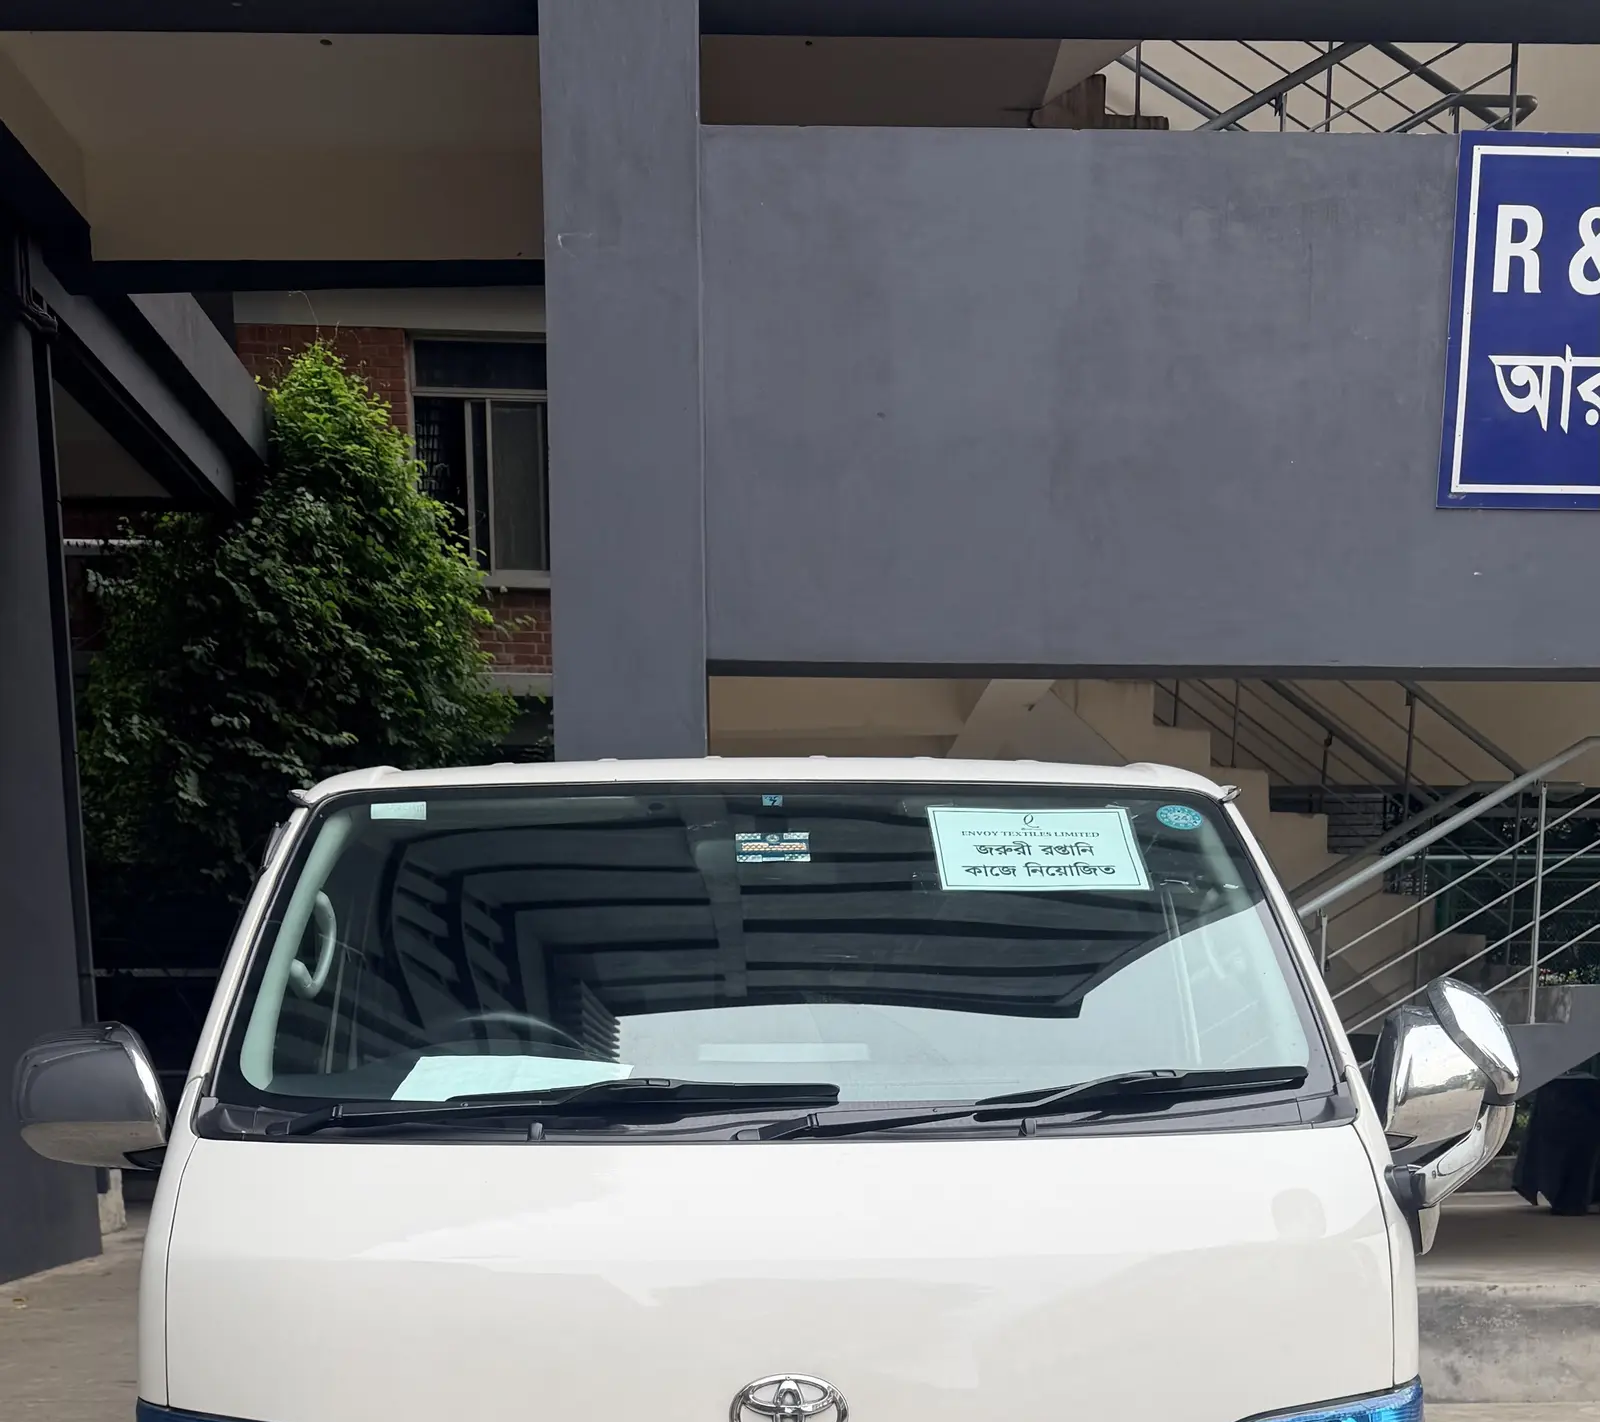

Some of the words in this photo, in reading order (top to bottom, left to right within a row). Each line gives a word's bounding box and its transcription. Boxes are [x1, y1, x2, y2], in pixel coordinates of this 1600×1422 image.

[1492, 204, 1543, 293] R
[1002, 830, 1052, 838] TEXTILES
[1054, 830, 1100, 838] LIMITED
[973, 841, 1033, 857] জরুরী
[1041, 841, 1094, 857] রপ্তানি
[962, 864, 1017, 877] কাজে
[1023, 861, 1116, 877] নিয়োজিত
